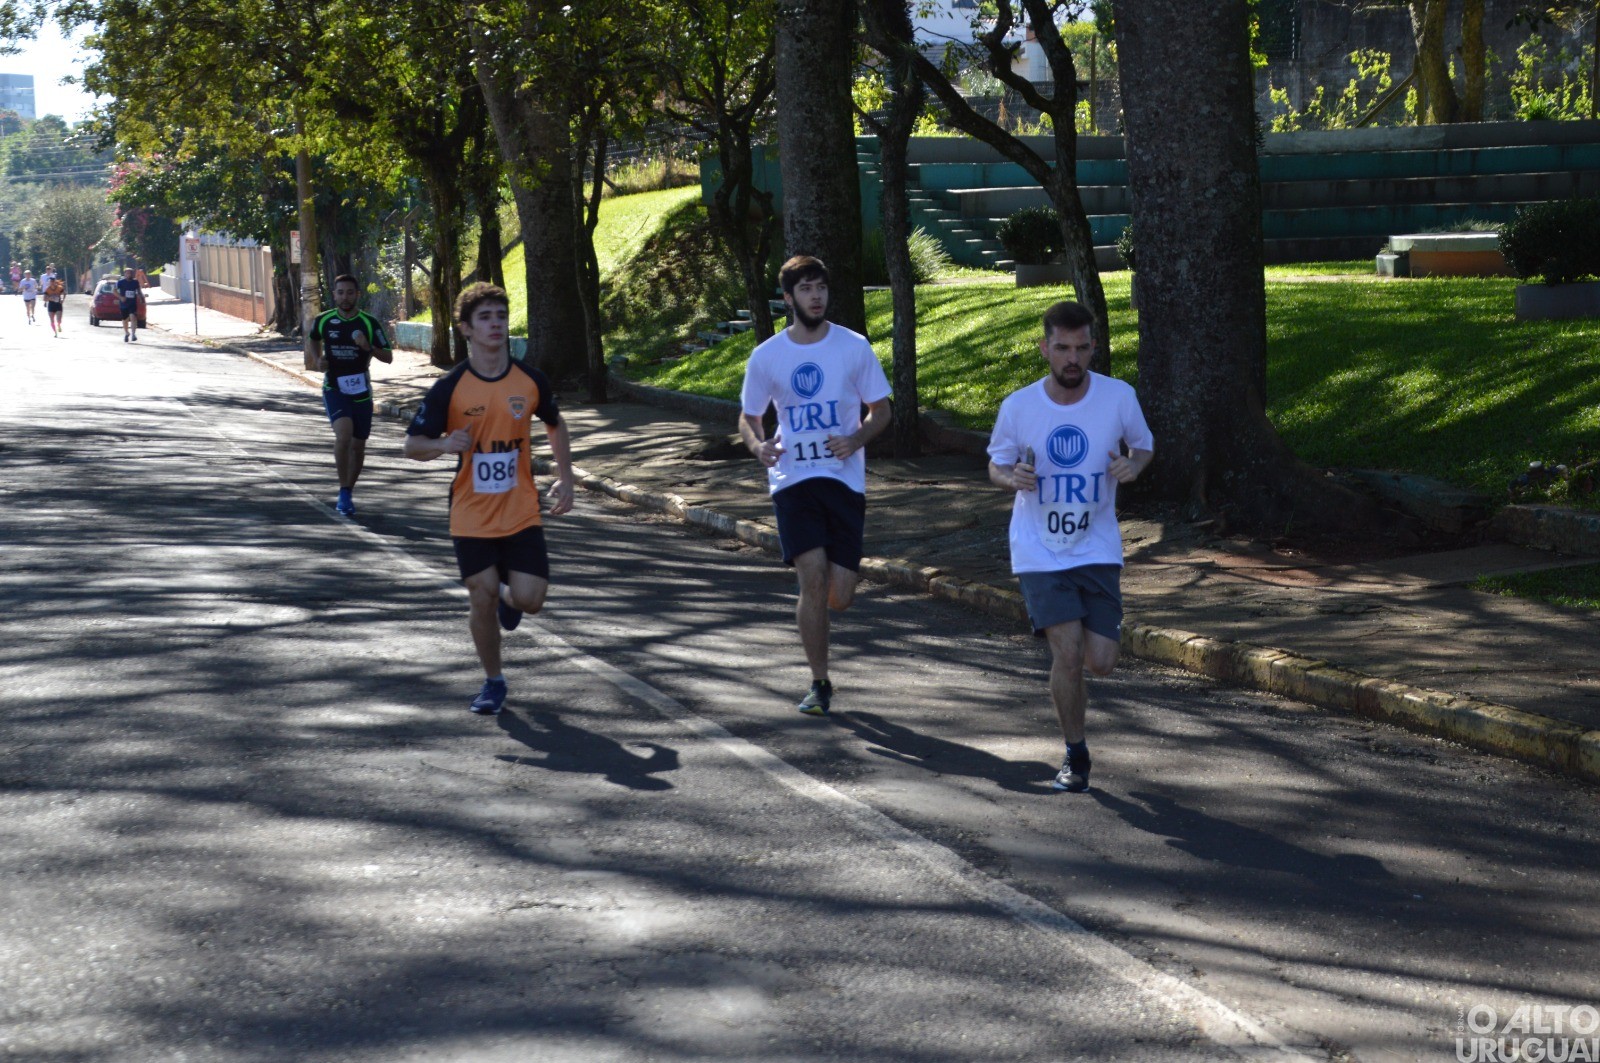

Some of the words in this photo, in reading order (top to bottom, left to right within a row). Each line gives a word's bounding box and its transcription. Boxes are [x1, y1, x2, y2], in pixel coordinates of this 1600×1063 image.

[344, 377, 361, 387] 154
[785, 400, 841, 432] URI
[478, 458, 515, 481] 086
[1037, 472, 1104, 504] URI
[1048, 511, 1090, 535] 064
